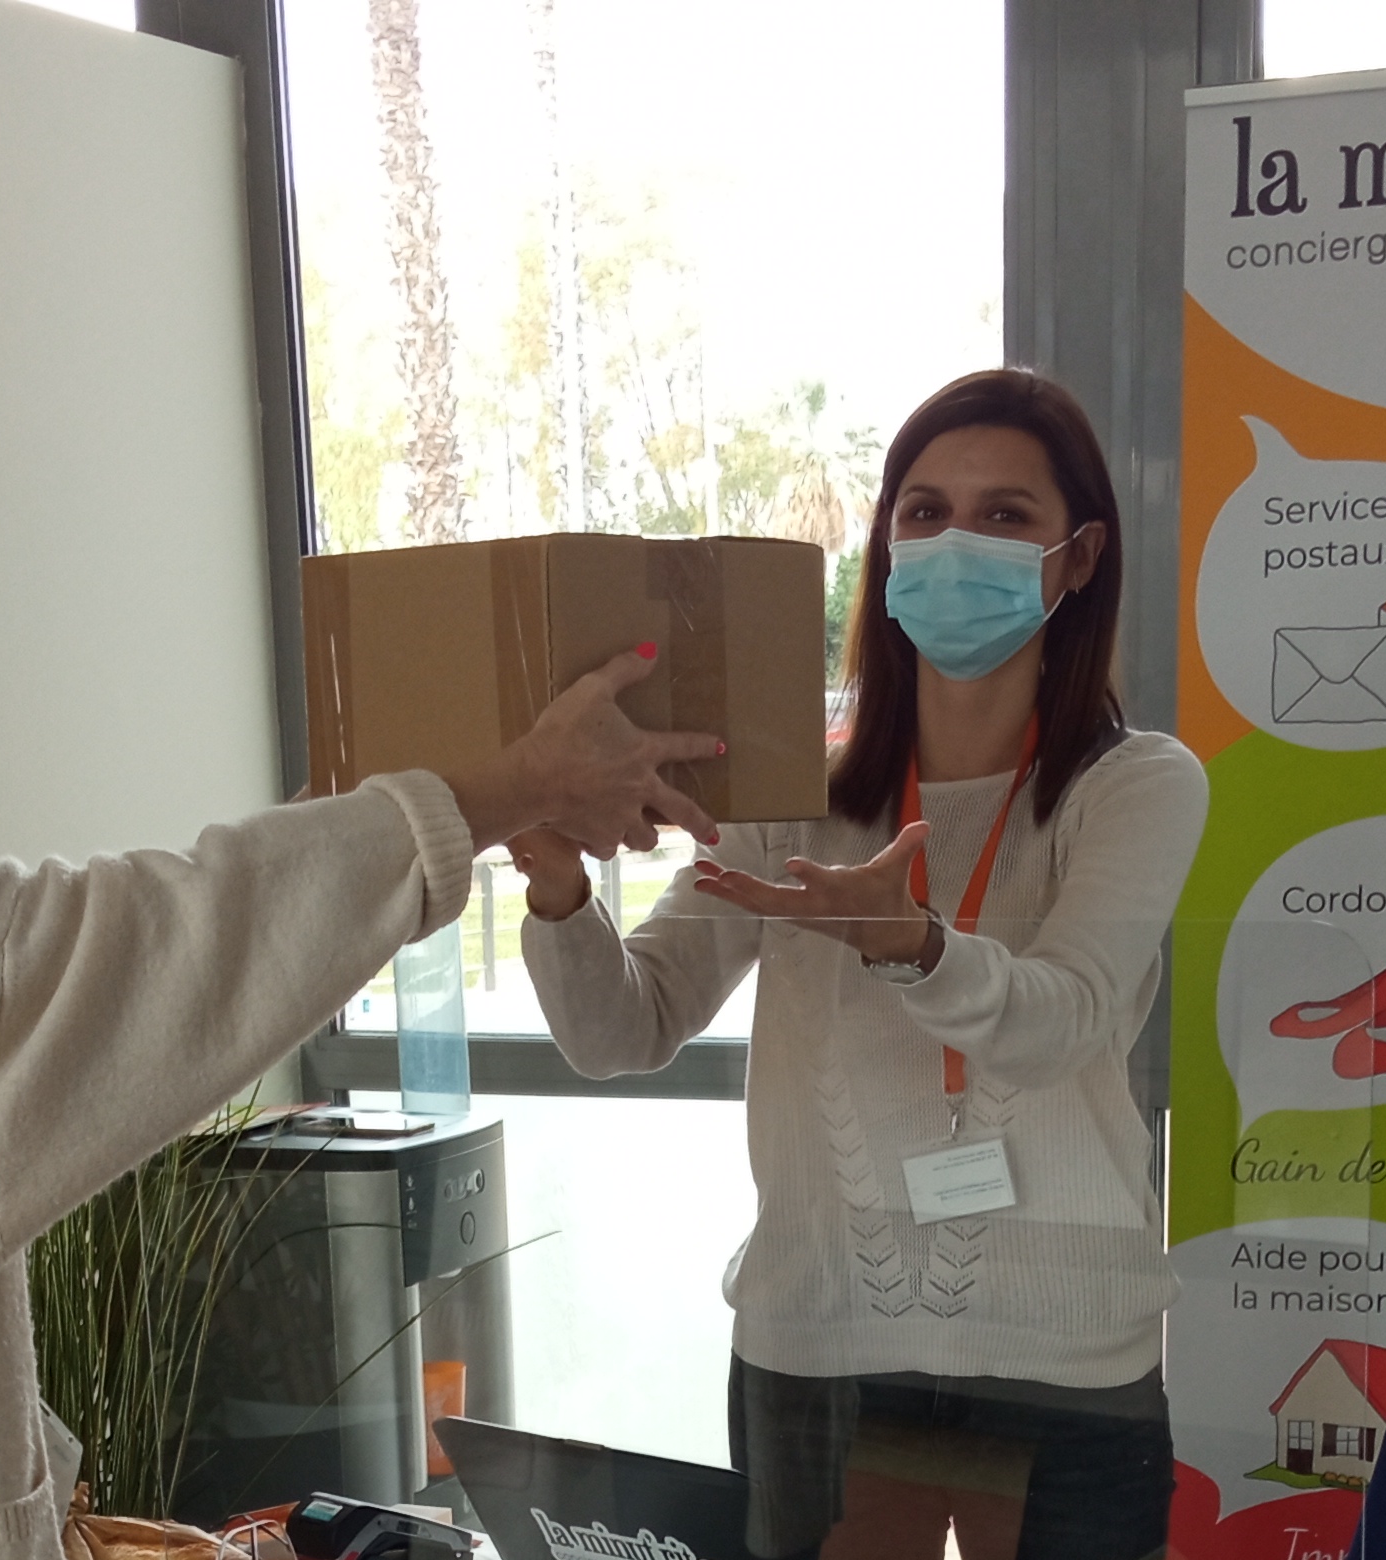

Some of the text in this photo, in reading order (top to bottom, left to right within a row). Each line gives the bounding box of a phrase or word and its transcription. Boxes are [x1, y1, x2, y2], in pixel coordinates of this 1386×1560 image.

[1230, 116, 1308, 218] la
[1229, 1138, 1325, 1186] Gain
[1230, 1240, 1308, 1272] Aide
[1231, 1282, 1261, 1311] la
[532, 1511, 575, 1549] la
